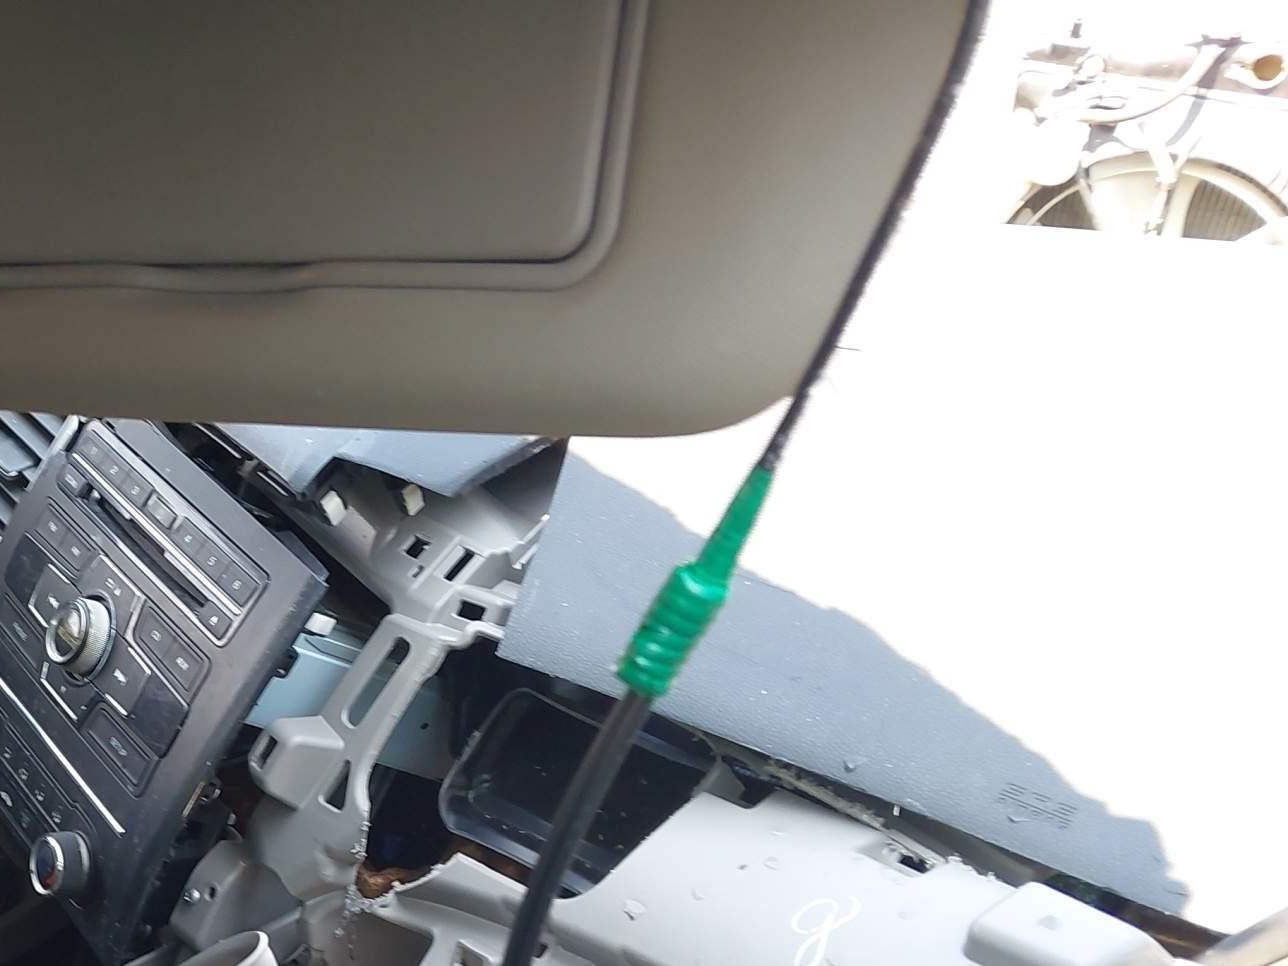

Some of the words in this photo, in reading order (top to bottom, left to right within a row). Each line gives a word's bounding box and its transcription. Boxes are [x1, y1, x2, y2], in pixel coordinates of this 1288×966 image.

[108, 465, 120, 475] 2
[206, 555, 218, 567] 5
[231, 579, 243, 591] 6
